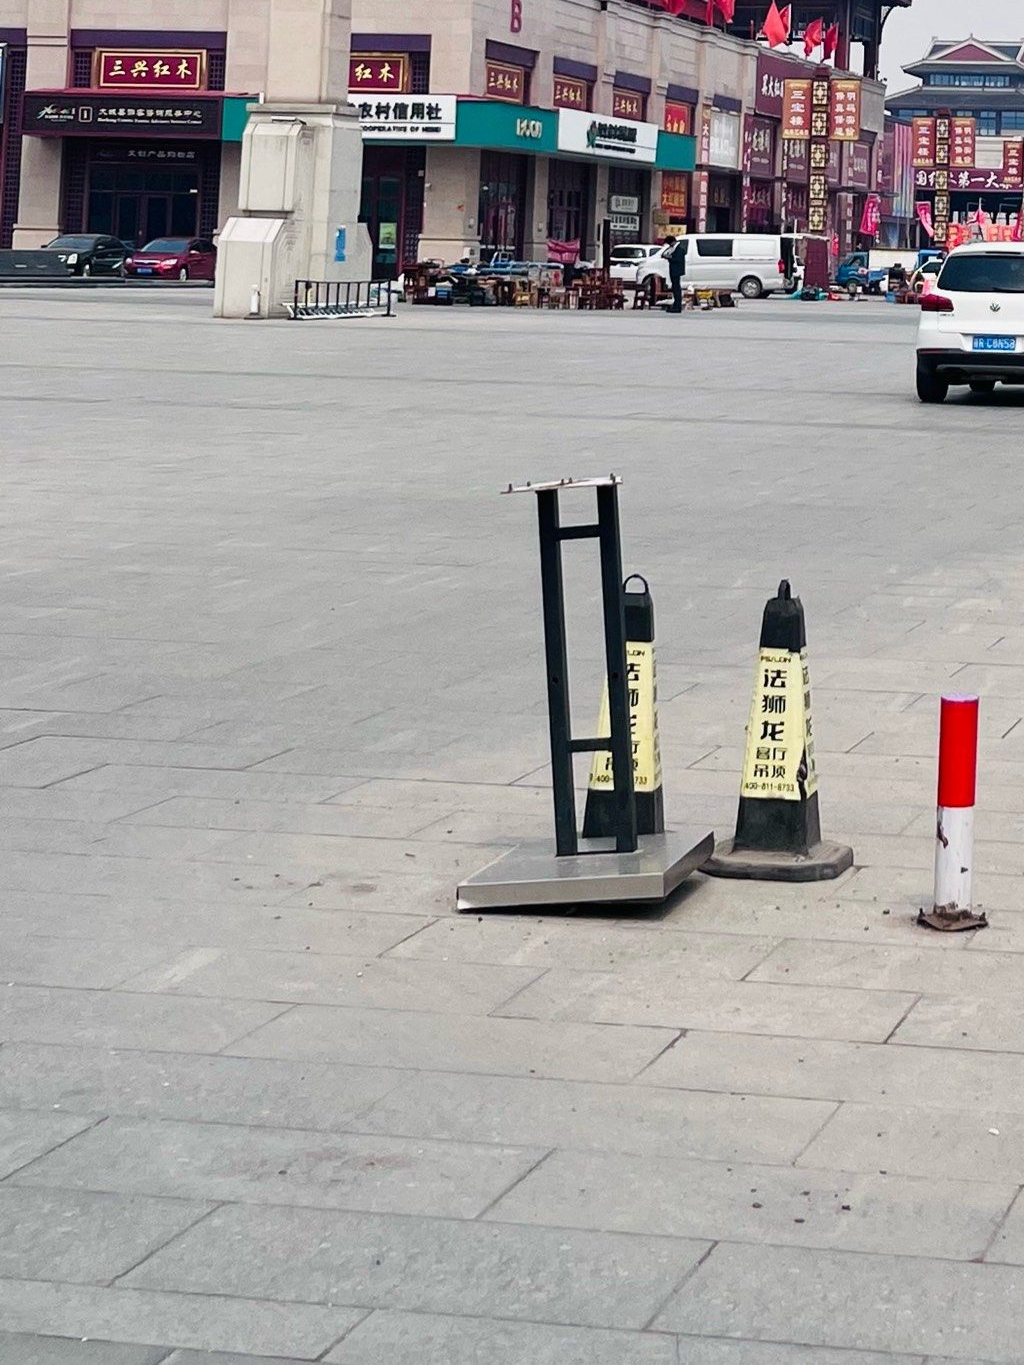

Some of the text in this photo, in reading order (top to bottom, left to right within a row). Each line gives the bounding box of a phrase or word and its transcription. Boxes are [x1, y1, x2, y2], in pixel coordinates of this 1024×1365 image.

[108, 59, 192, 79] 三兴红木
[354, 62, 395, 82] 红木
[488, 71, 519, 92] 三兴红木
[555, 85, 584, 105] 三兴红木
[347, 102, 442, 120] 农村信用社
[760, 668, 787, 742] 法狮龙
[753, 764, 786, 779] 吊顶
